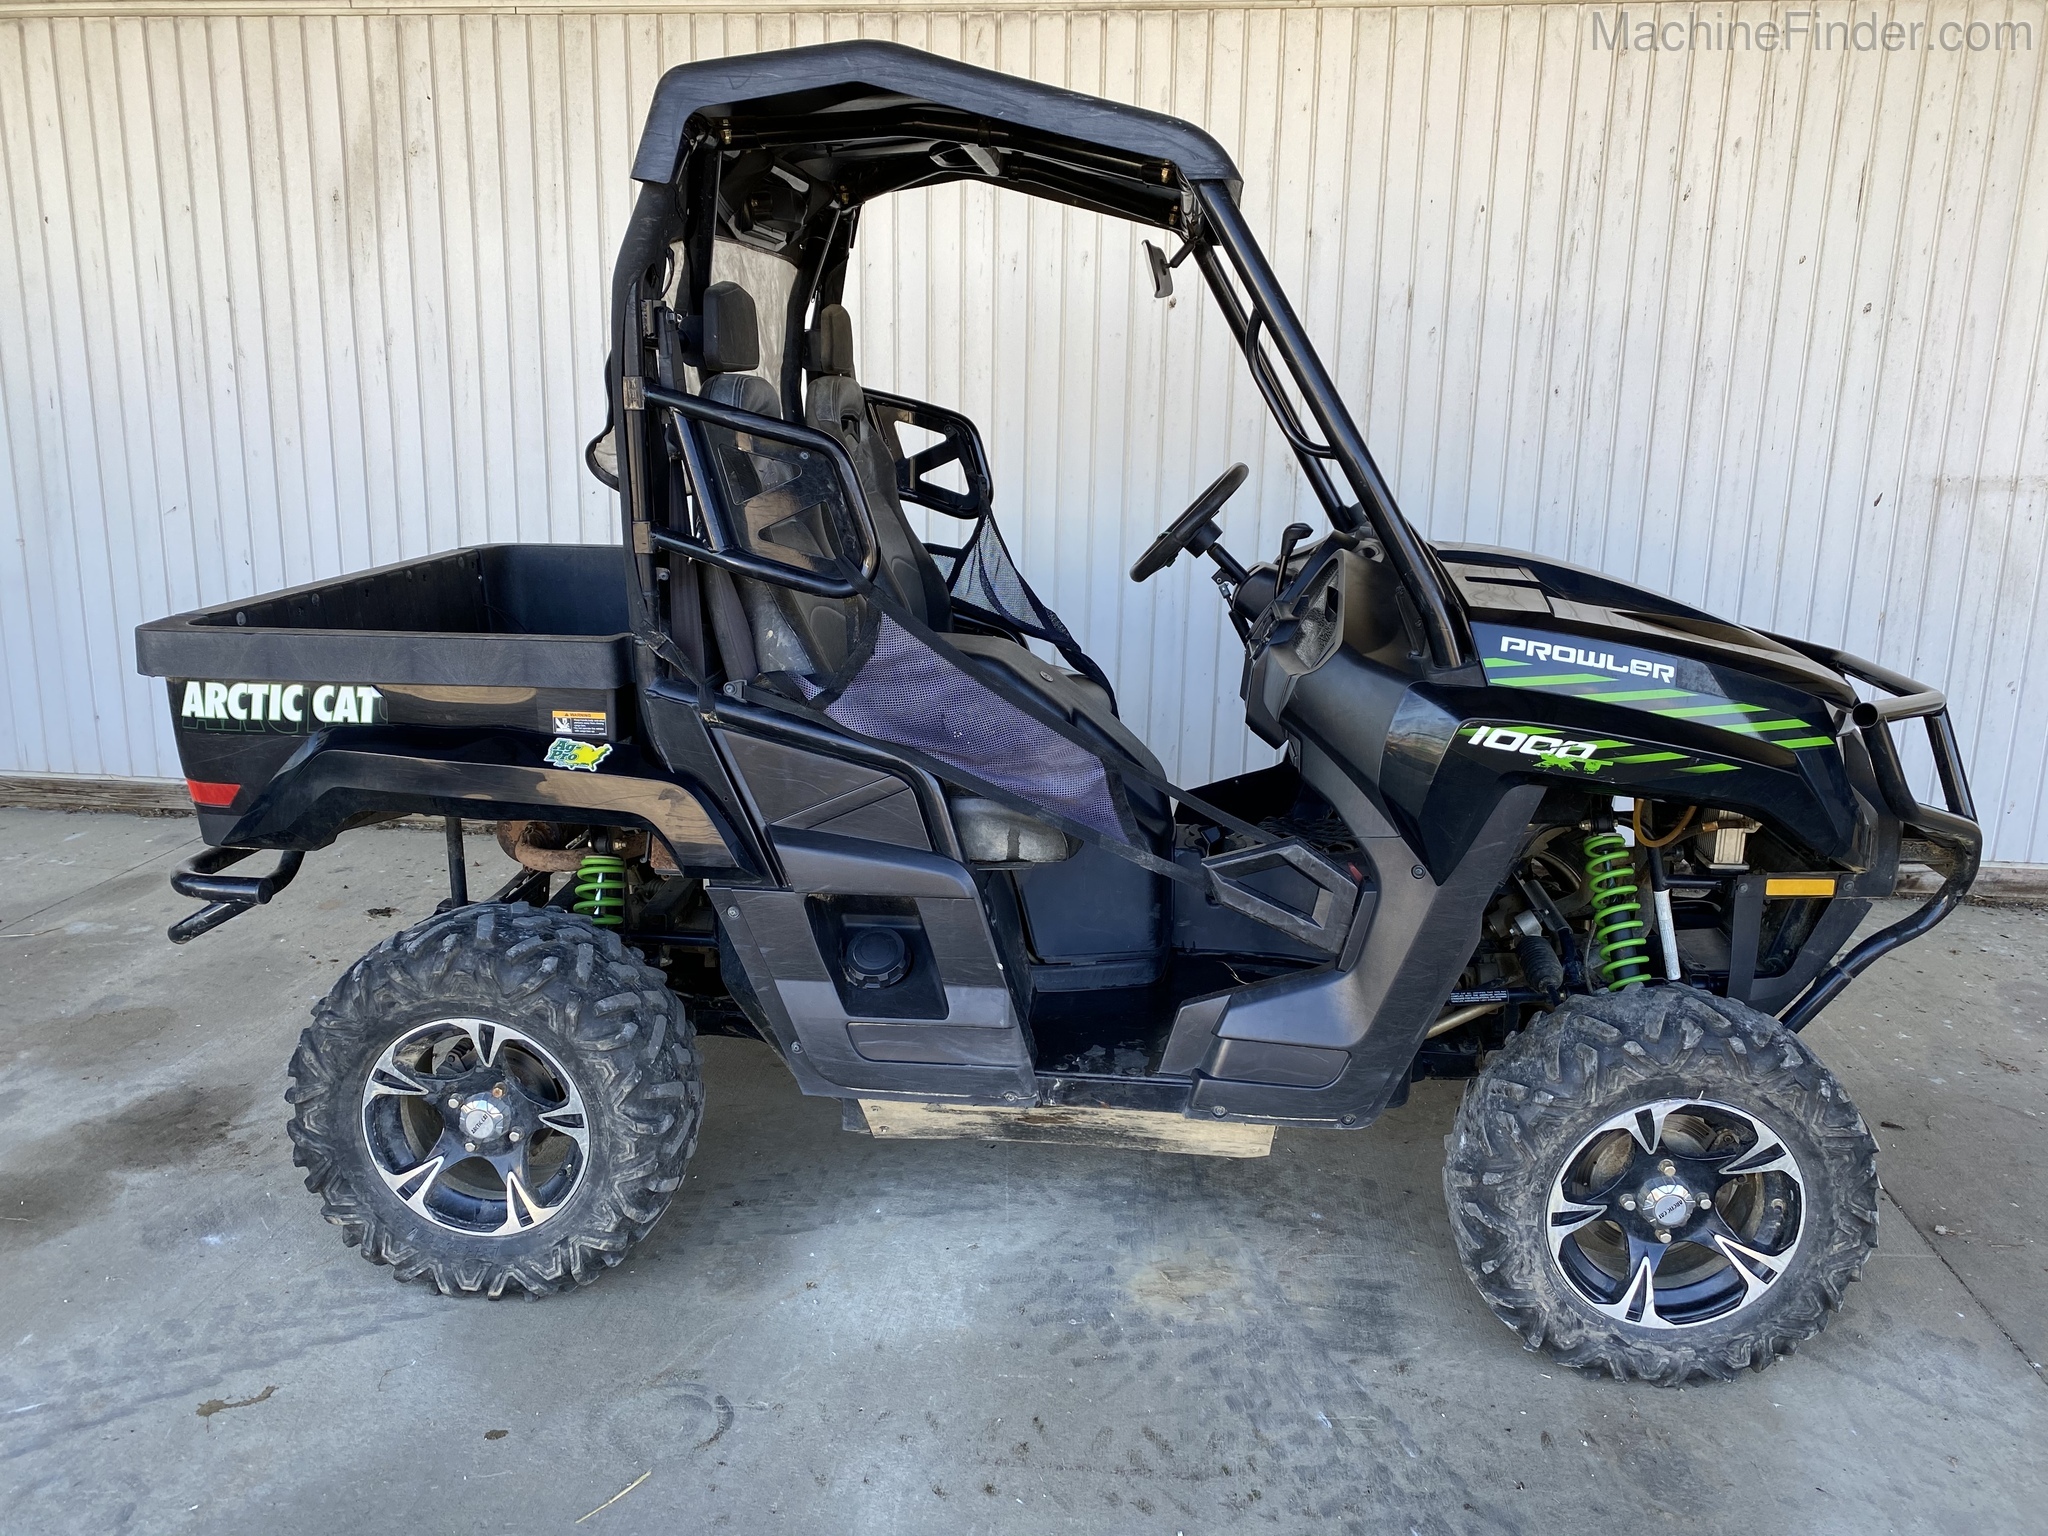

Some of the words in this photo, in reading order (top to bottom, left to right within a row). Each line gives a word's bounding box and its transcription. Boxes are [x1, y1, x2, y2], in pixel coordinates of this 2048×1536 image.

[1500, 635, 1676, 684] PROWLER
[181, 680, 304, 722] ARCTIC
[312, 684, 385, 724] CAT
[549, 750, 578, 760] Pro
[553, 740, 581, 753] Ag-
[1467, 725, 1598, 759] 1000
[1532, 752, 1614, 775] XT
